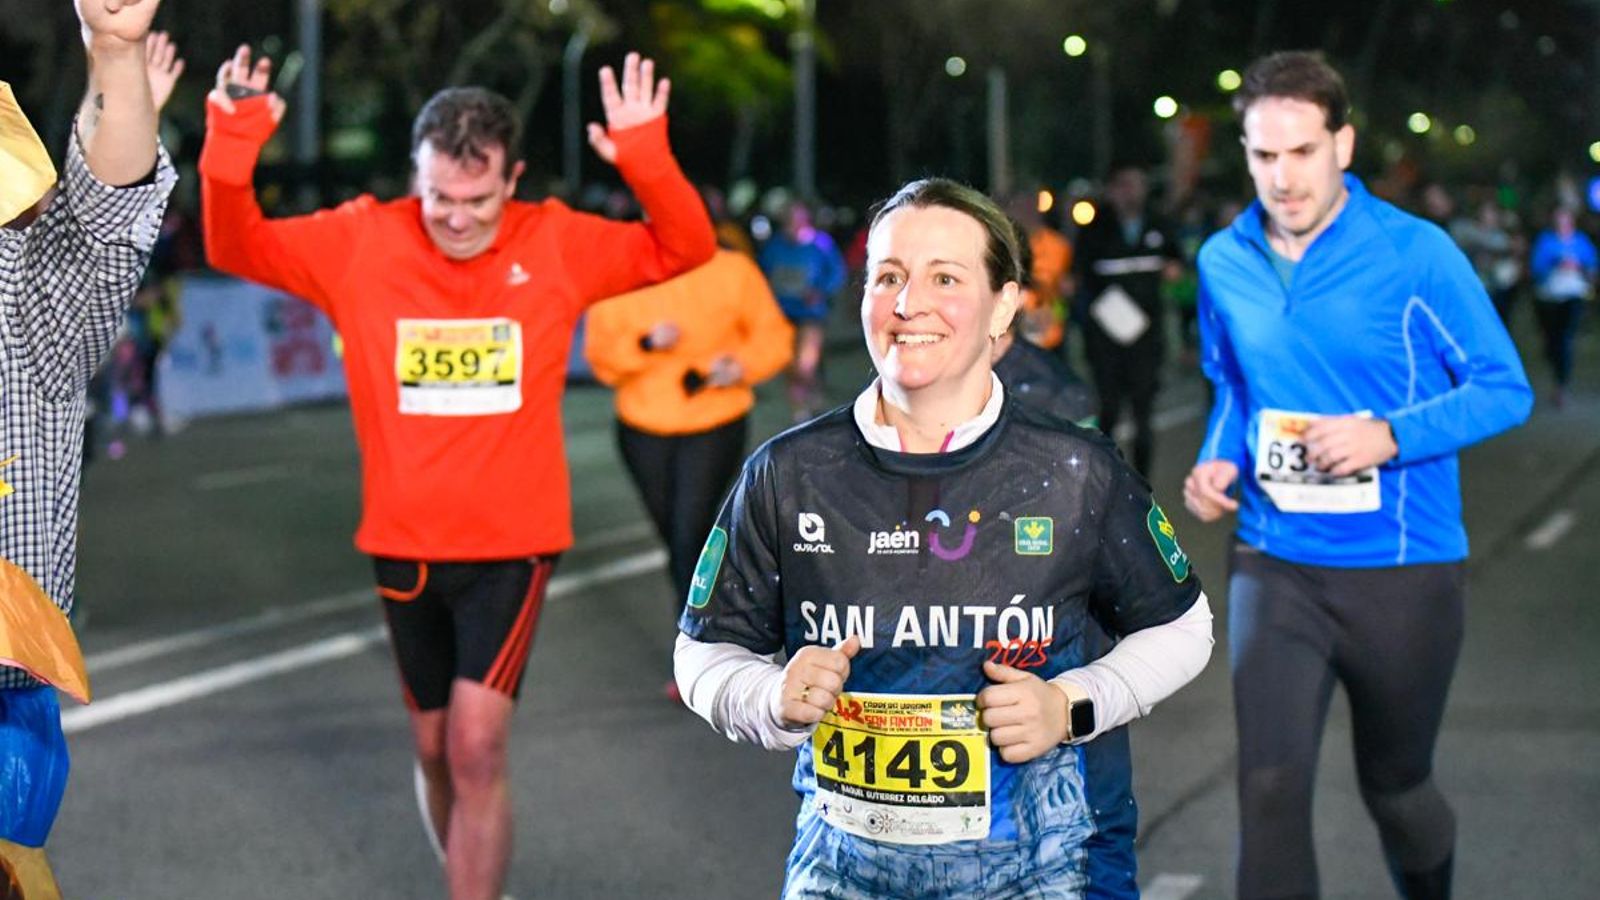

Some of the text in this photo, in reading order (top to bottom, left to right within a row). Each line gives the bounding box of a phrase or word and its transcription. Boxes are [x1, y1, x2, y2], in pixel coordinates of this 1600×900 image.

[408, 347, 506, 379] 3597
[1267, 441, 1309, 472] 63
[800, 594, 1054, 649] SAN ANTÓN
[985, 637, 1054, 669] 2025
[822, 729, 970, 789] 4149
